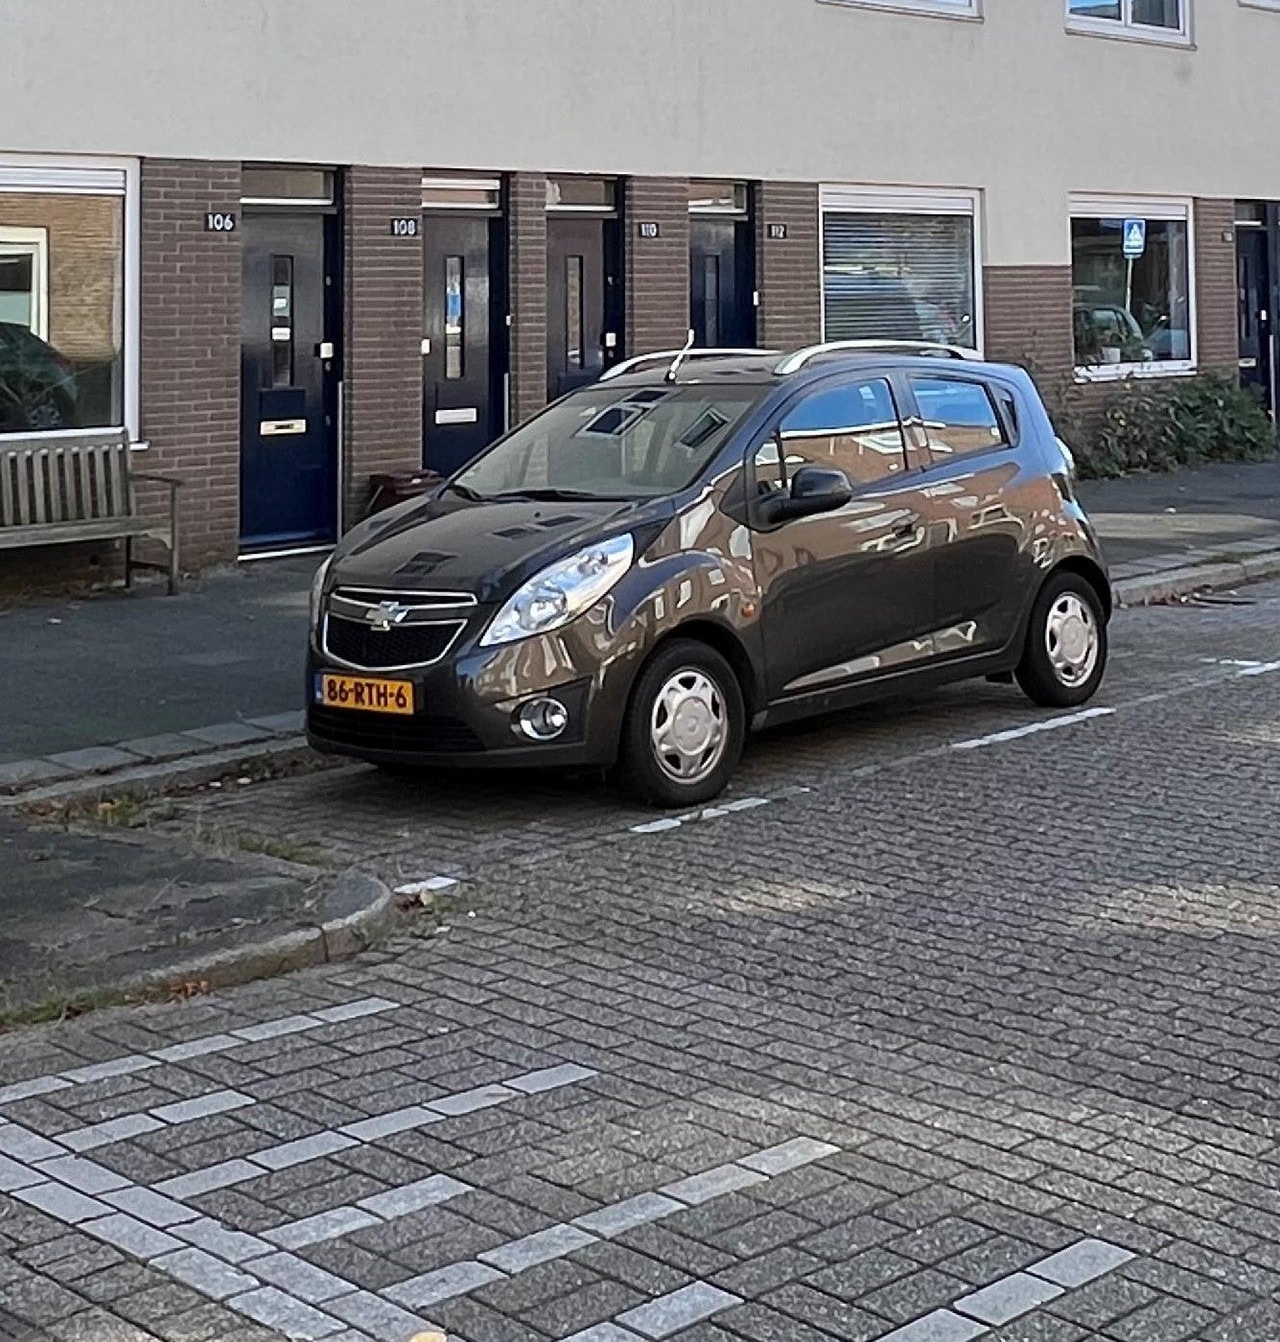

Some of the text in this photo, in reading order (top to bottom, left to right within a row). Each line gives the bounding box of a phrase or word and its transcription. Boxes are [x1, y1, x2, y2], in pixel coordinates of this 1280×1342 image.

[208, 213, 233, 230] 106
[393, 219, 415, 235] 108
[327, 679, 408, 709] 86-RTH-6
